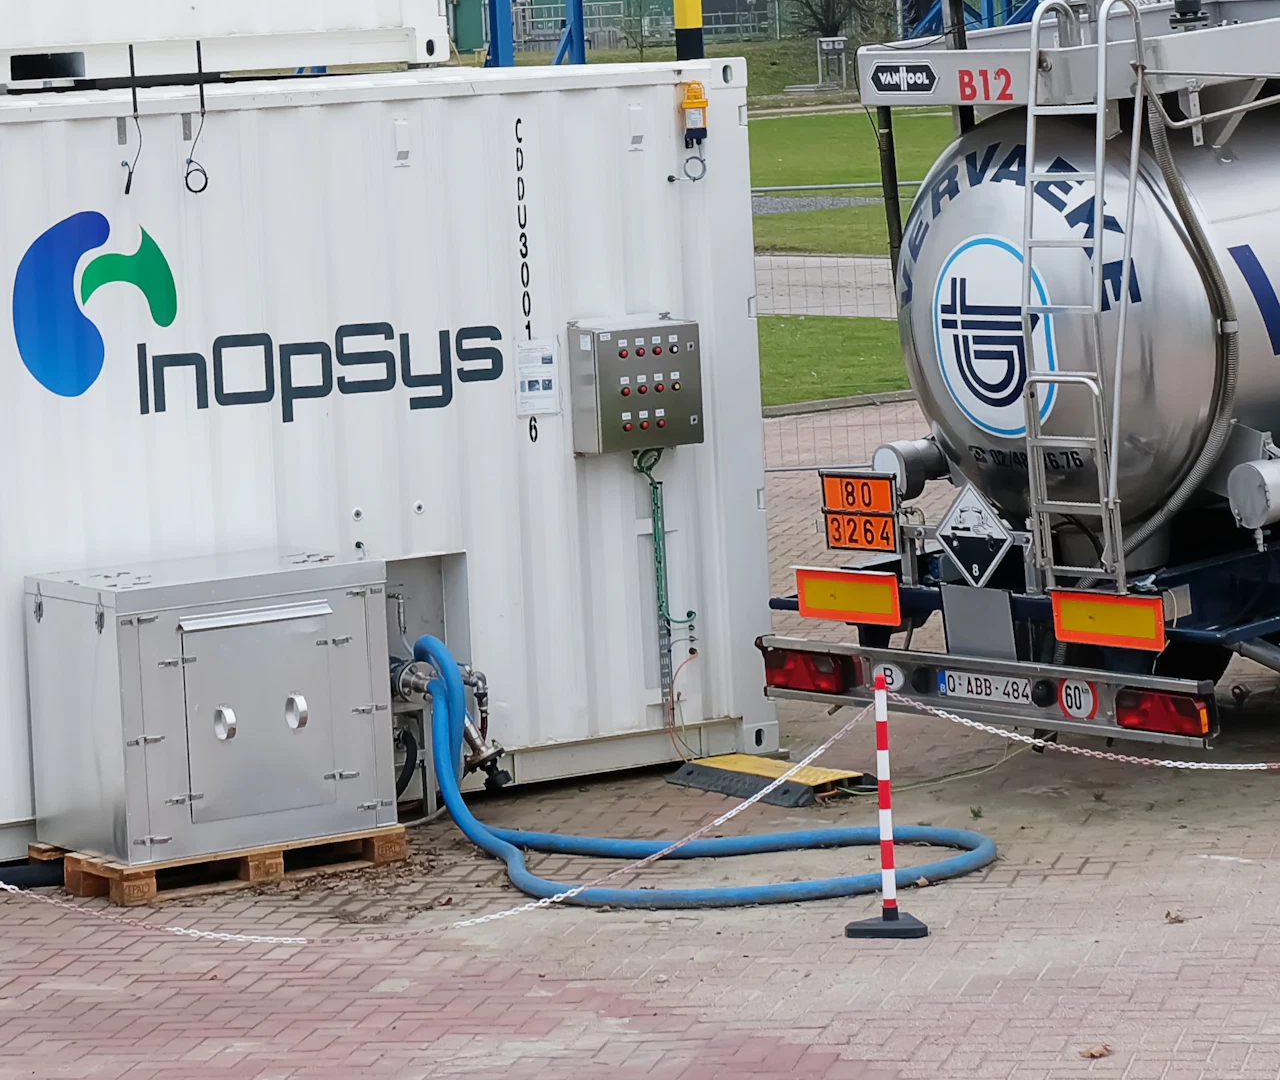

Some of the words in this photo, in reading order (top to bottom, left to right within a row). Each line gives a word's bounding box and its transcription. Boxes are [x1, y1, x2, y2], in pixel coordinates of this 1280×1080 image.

[958, 67, 1014, 101] B12
[137, 321, 504, 424] InOpSys
[843, 481, 873, 508] 80
[829, 517, 891, 547] 3264
[972, 563, 980, 576] 8
[883, 668, 895, 686] B
[940, 684, 947, 693] B
[1065, 685, 1082, 710] 60
